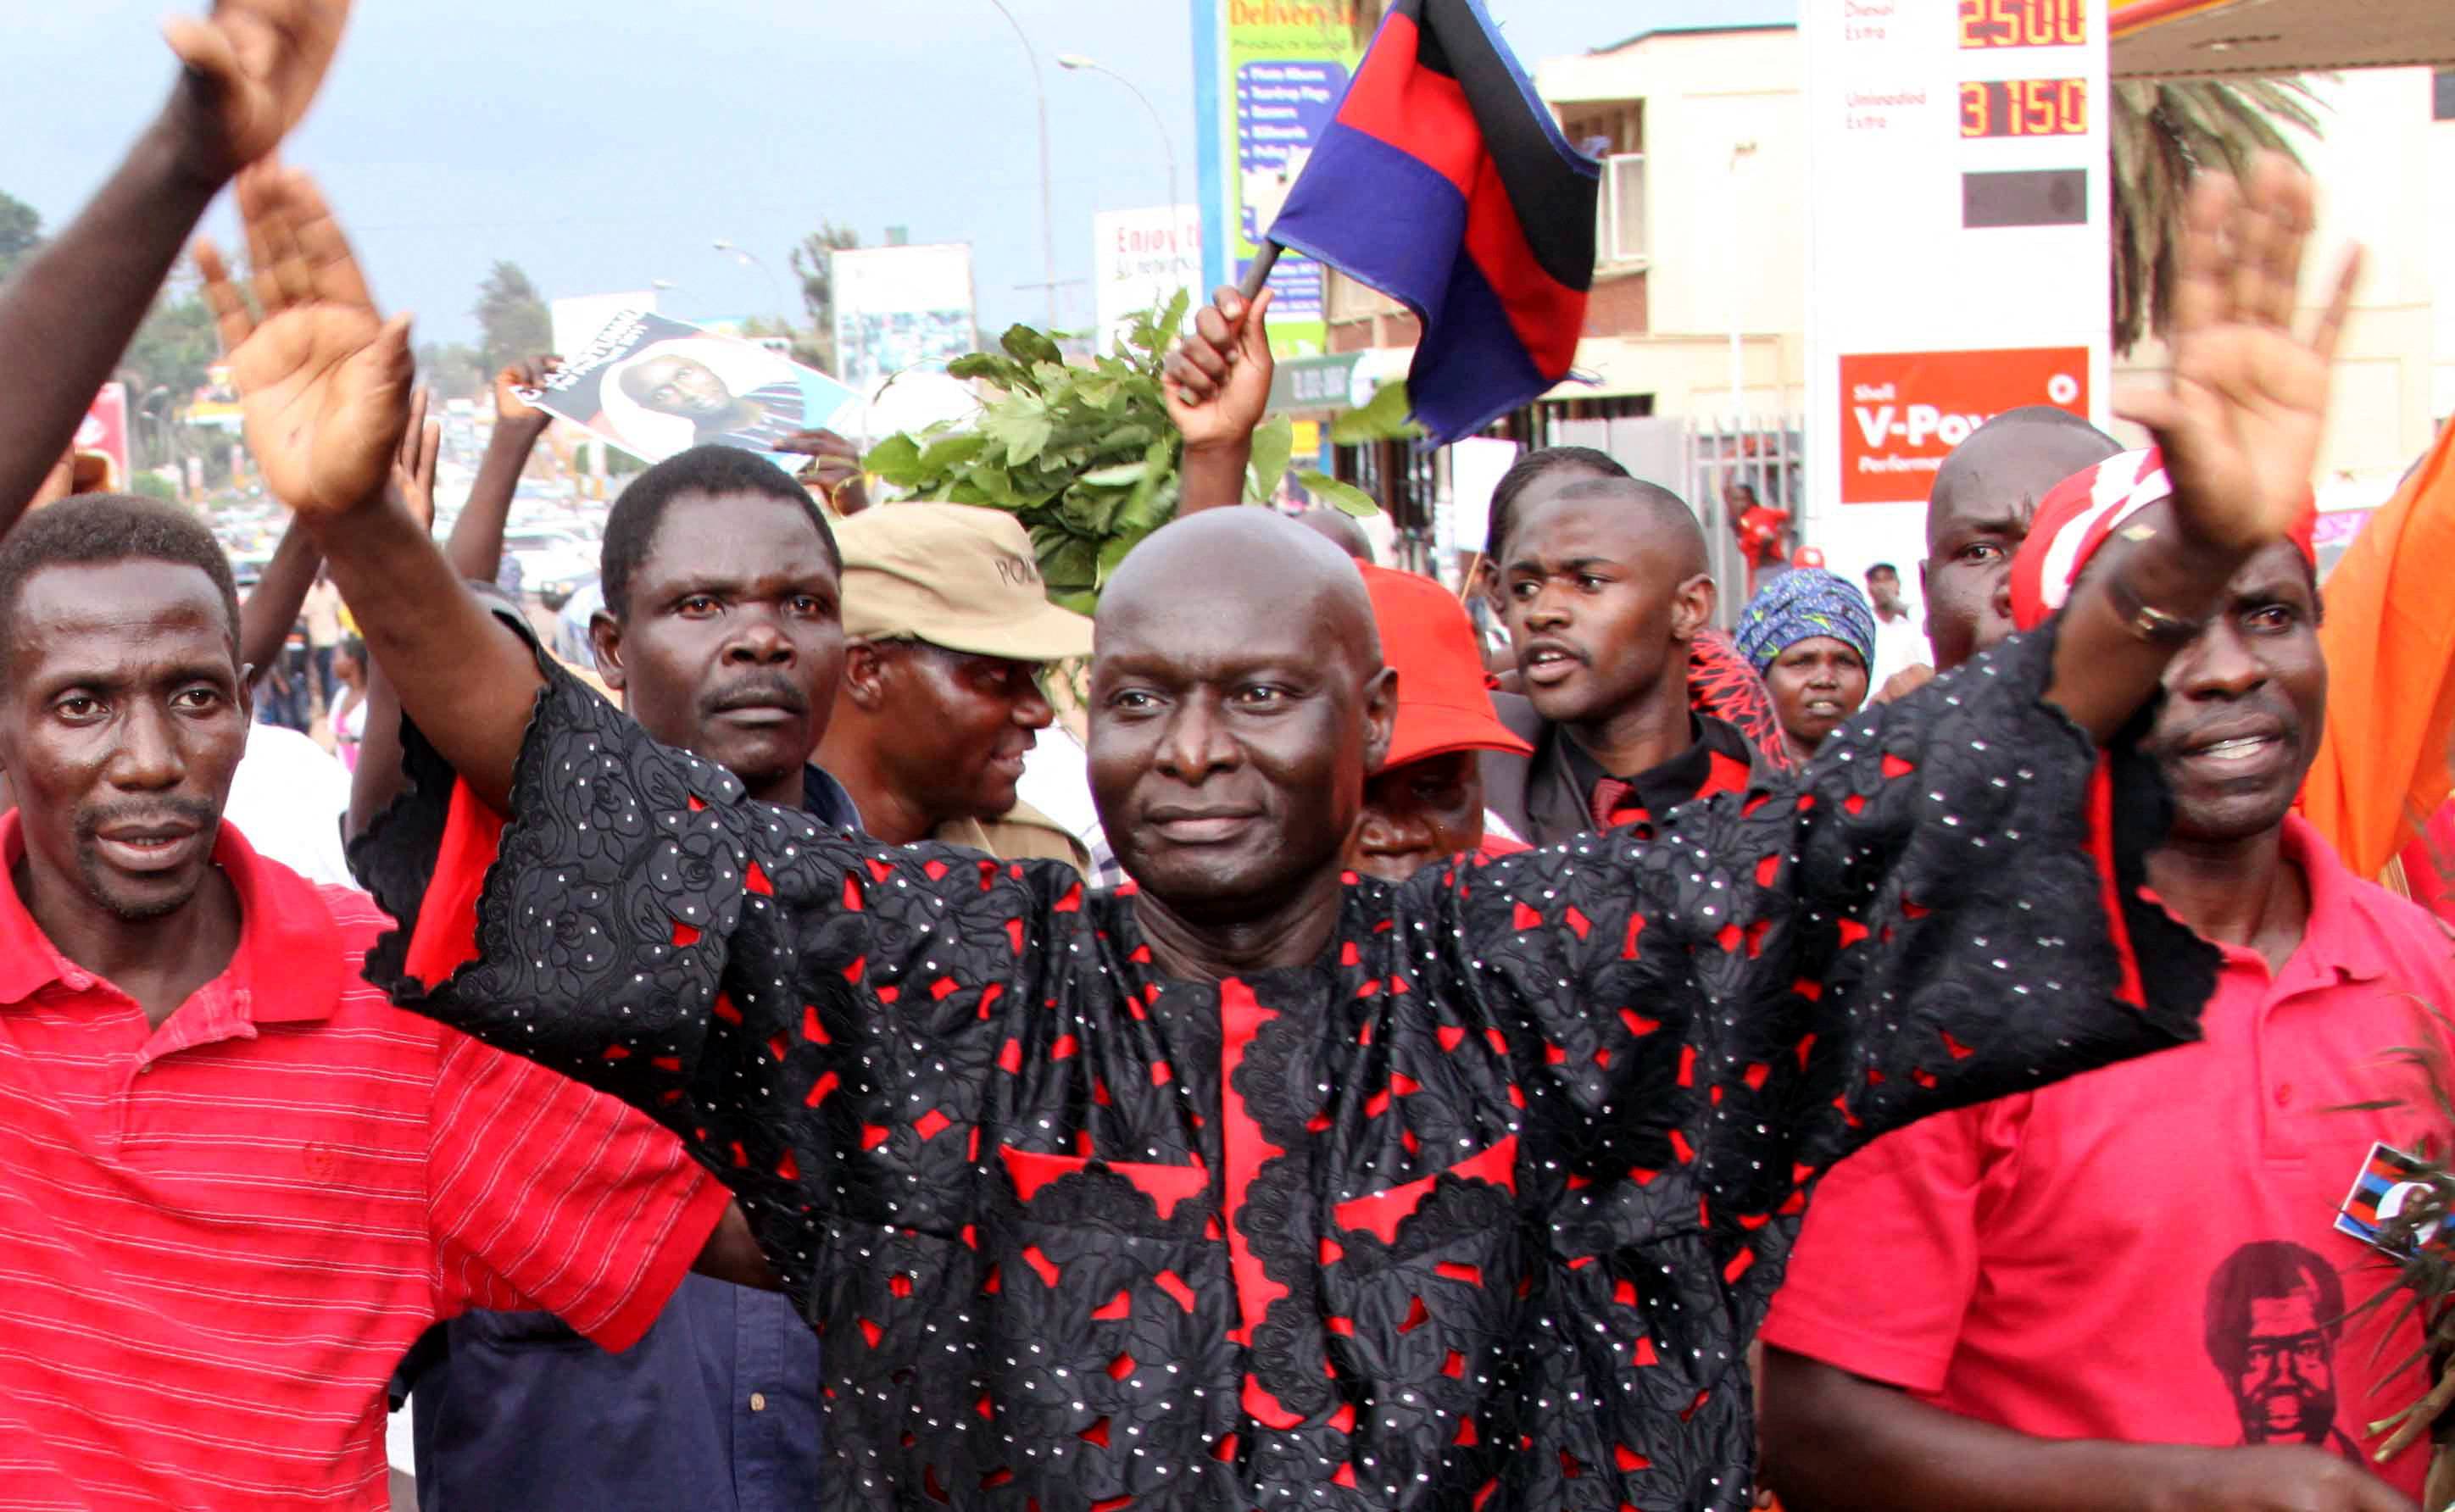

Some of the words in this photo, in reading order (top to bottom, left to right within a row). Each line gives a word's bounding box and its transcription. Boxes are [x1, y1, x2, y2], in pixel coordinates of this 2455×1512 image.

[1231, 0, 1328, 35] Delivery
[1959, 0, 2085, 47] 2500
[1845, 23, 1886, 41] Extra
[1845, 112, 1887, 131] Extra
[1116, 226, 1177, 253] Enjoy
[1853, 383, 1896, 401] Shell
